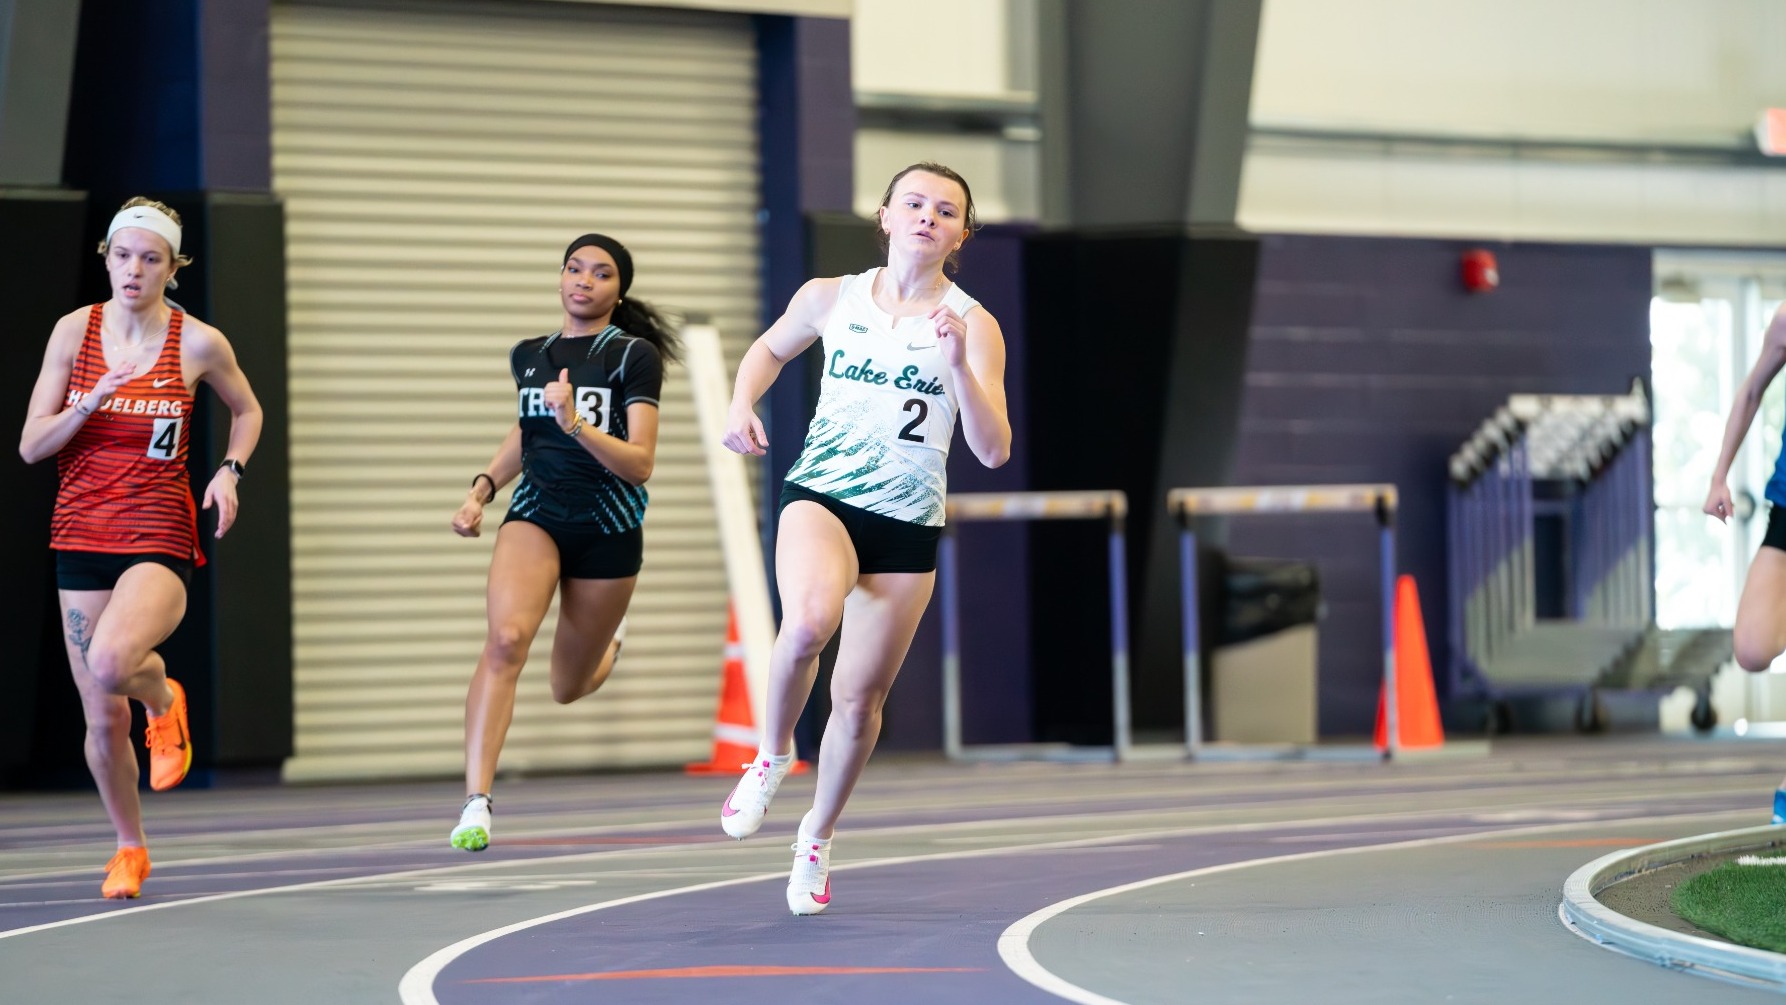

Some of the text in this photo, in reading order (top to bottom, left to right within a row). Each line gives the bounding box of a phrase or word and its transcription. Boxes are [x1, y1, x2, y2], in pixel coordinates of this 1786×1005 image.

[829, 349, 945, 395] Lake Erie
[581, 390, 604, 429] 3
[898, 398, 928, 443] 2
[153, 421, 177, 457] 4
